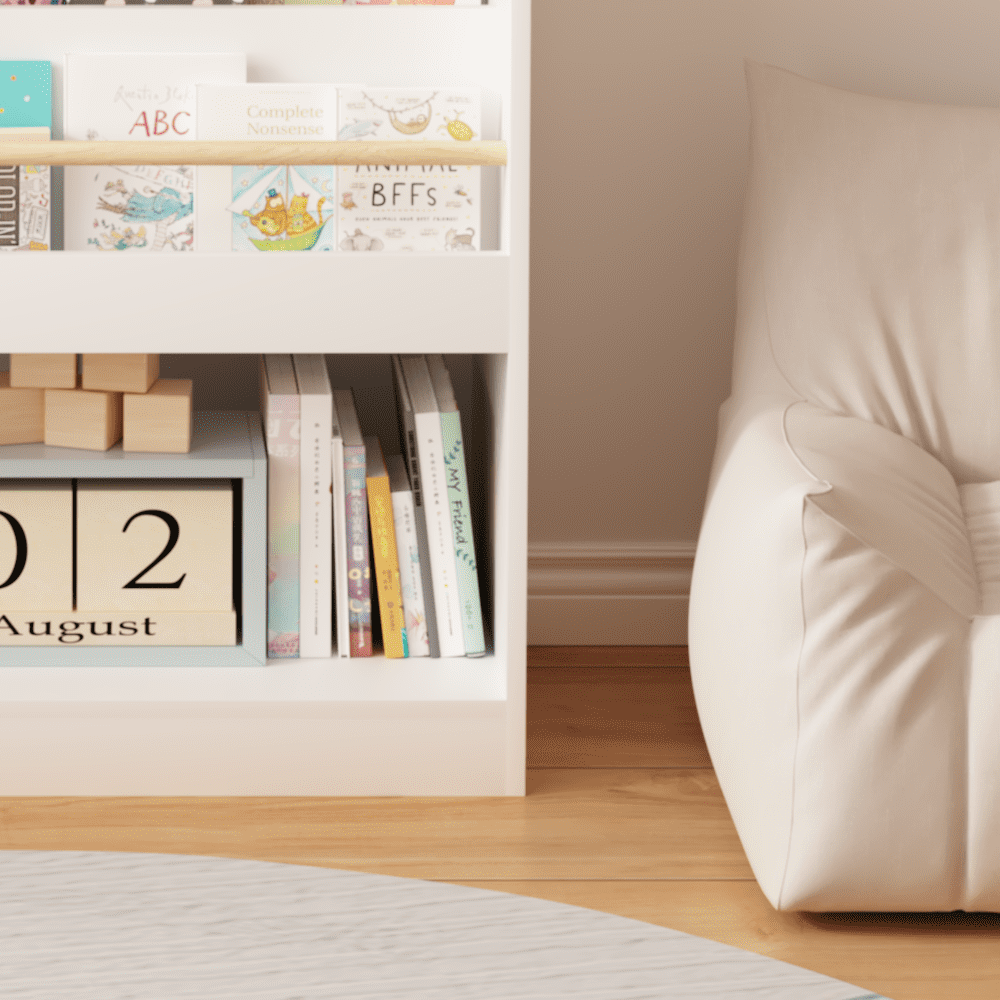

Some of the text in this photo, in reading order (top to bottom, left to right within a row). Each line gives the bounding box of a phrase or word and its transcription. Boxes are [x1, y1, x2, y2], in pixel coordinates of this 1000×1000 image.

[127, 109, 191, 138] ABC
[246, 104, 325, 122] Complete
[246, 122, 325, 136] Nonsense
[450, 499, 469, 545] Friend
[120, 509, 188, 590] 2
